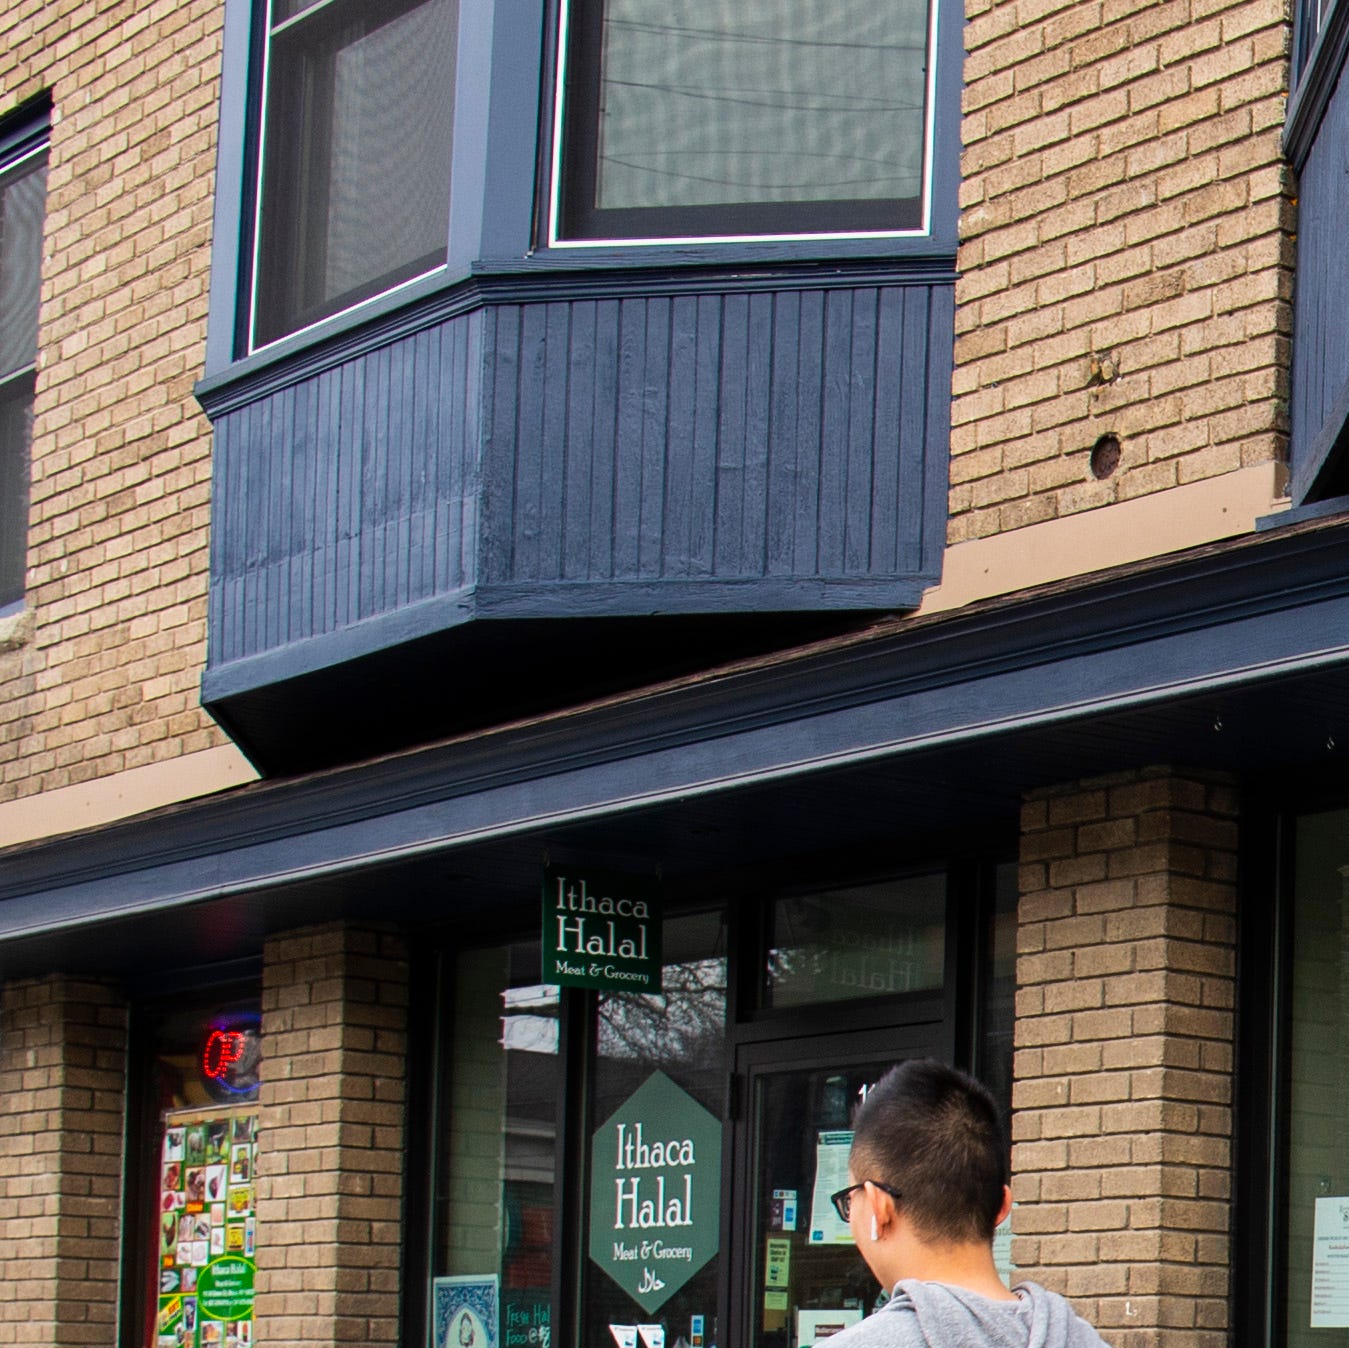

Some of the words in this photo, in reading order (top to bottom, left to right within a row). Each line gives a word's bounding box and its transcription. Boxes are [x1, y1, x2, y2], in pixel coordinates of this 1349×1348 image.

[556, 876, 650, 919] Ithaca
[556, 915, 649, 960] Halal
[555, 960, 586, 976] Meat
[589, 963, 603, 977] &
[604, 965, 650, 984] Grocery
[615, 1123, 695, 1169] Ithaca
[614, 1175, 693, 1229] Halal
[613, 1243, 638, 1261] Meat
[640, 1241, 653, 1260] &
[653, 1240, 692, 1261] Grocery
